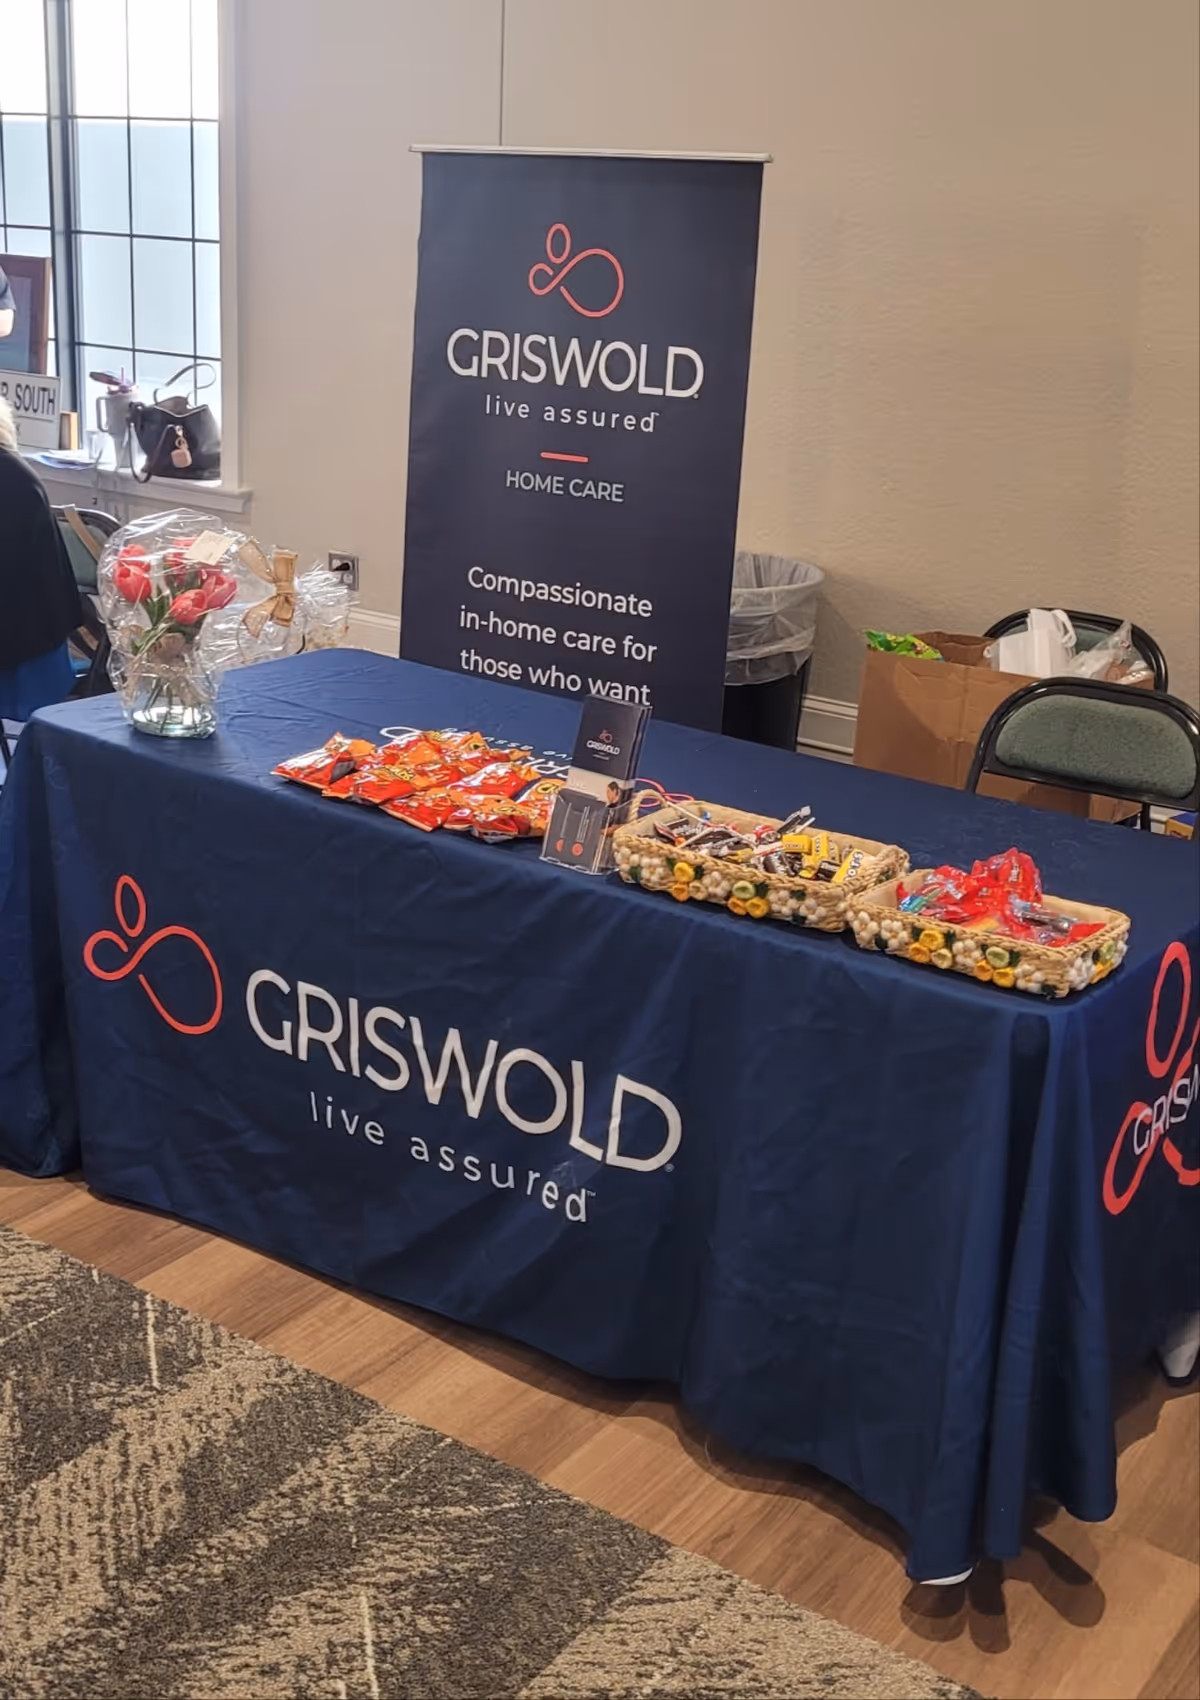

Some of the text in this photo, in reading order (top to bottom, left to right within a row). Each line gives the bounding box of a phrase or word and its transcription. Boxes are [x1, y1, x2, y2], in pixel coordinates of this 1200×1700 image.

[447, 328, 704, 399] GRISWOLD
[15, 383, 56, 415] SOUTH
[486, 395, 530, 418] live
[506, 470, 624, 502] HOME CARE
[467, 566, 653, 617] Compassionate
[460, 605, 657, 663] in-home care for
[460, 650, 651, 706] those who want
[246, 968, 683, 1173] GRISWOLD
[310, 1091, 385, 1145] live
